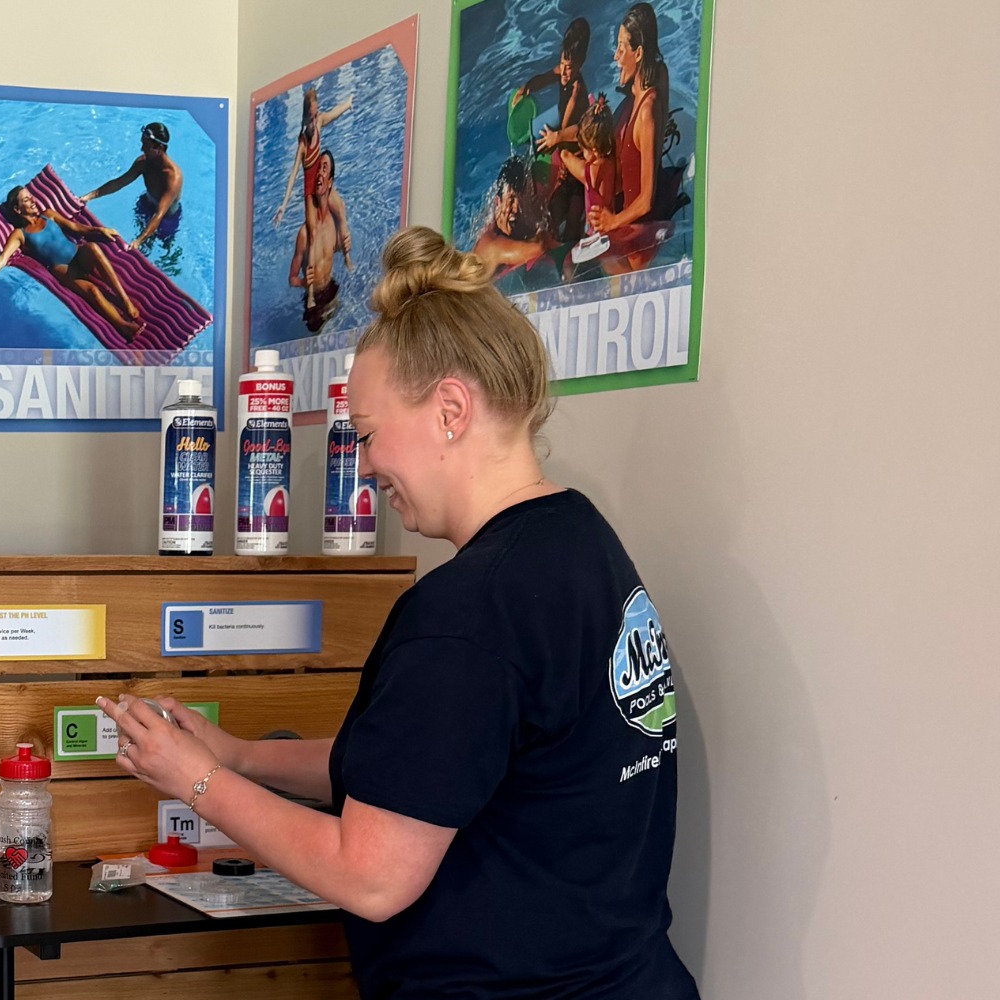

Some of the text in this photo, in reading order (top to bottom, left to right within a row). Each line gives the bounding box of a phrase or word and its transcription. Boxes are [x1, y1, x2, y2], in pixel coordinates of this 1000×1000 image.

[528, 286, 691, 381] NTROL
[256, 383, 287, 391] BONUS
[269, 397, 289, 405] MORE
[256, 420, 287, 428] Elements
[176, 436, 210, 451] Hello
[173, 618, 184, 635] S
[66, 722, 78, 739] C
[170, 816, 194, 831] Tm
